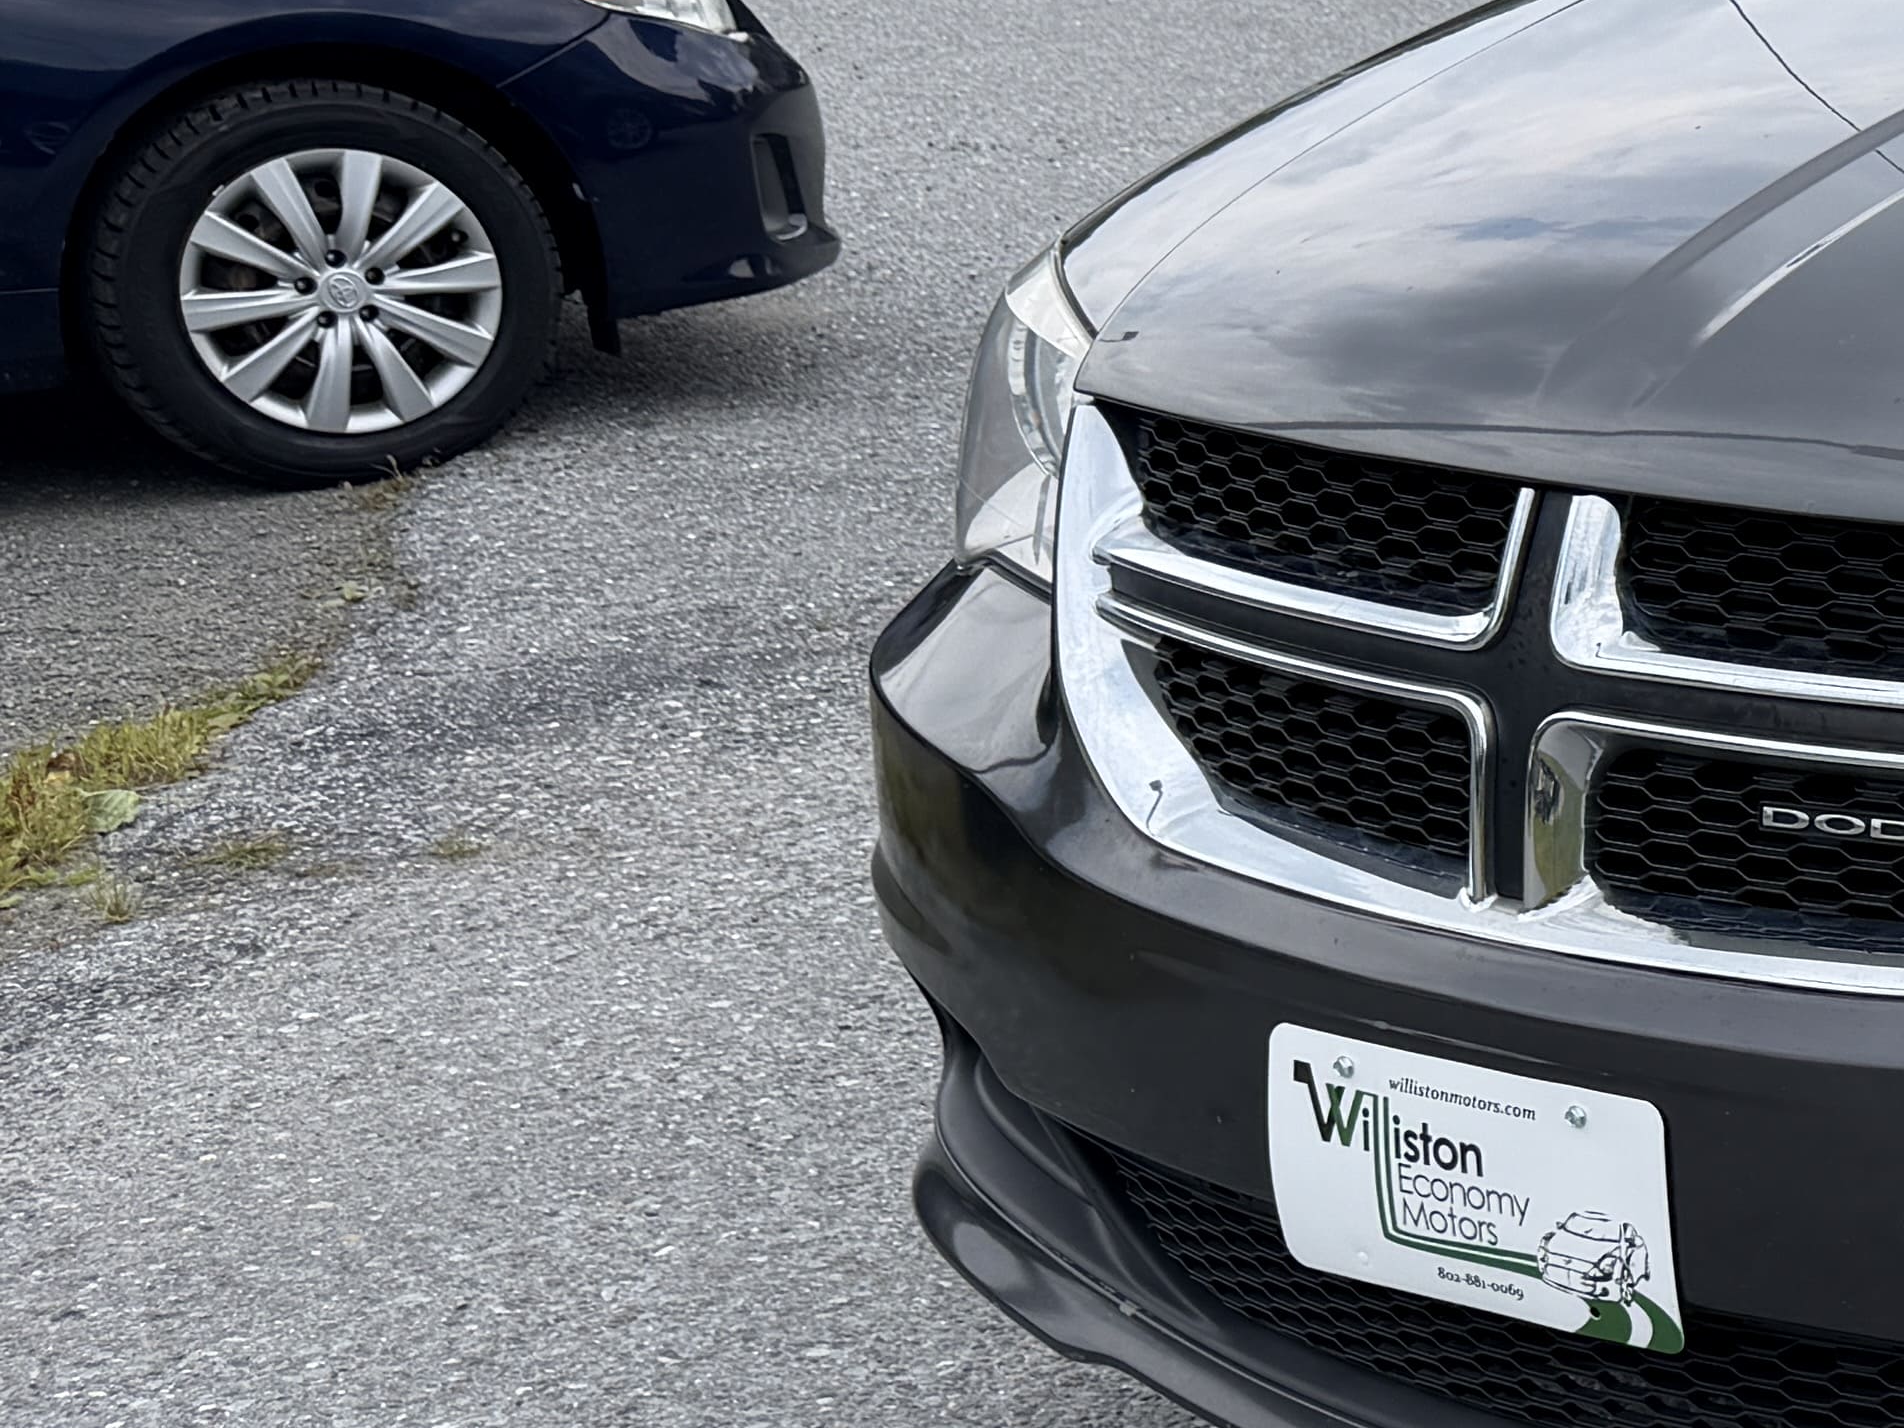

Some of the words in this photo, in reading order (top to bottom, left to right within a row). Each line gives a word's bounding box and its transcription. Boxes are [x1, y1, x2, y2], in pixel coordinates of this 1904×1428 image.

[1293, 1059, 1485, 1178] Williston
[1388, 1077, 1537, 1121] willistonmotors.com
[1397, 1162, 1531, 1227] Economy
[1402, 1197, 1499, 1246] Motors
[1437, 1266, 1525, 1301] 802-881-0069
